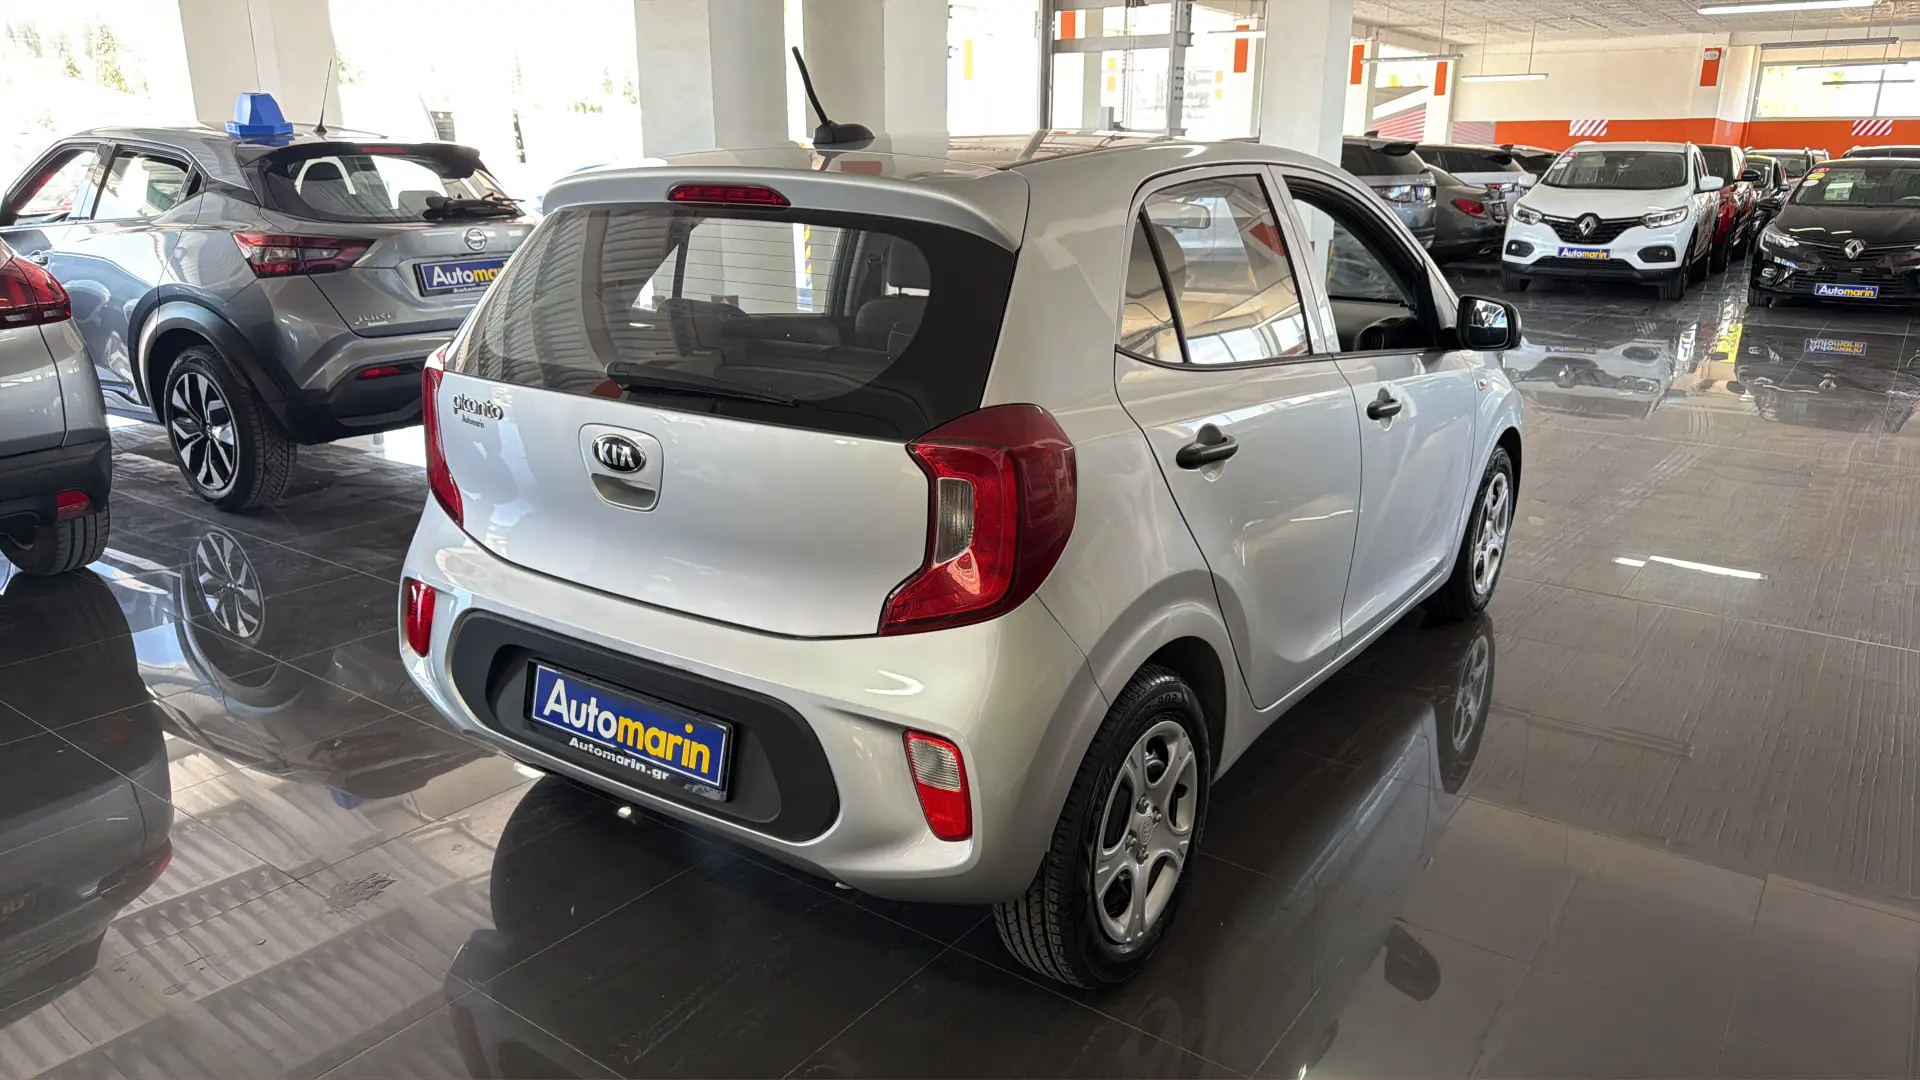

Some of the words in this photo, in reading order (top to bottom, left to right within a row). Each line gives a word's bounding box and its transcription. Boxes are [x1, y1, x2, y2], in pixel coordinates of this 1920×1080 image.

[1560, 248, 1608, 259] Automarin
[432, 266, 503, 286] Automa
[1818, 284, 1875, 297] Automarin
[453, 393, 504, 421] picanto
[597, 440, 636, 468] KIA
[542, 678, 711, 774] Automarin
[568, 737, 669, 780] Automarin.gr
